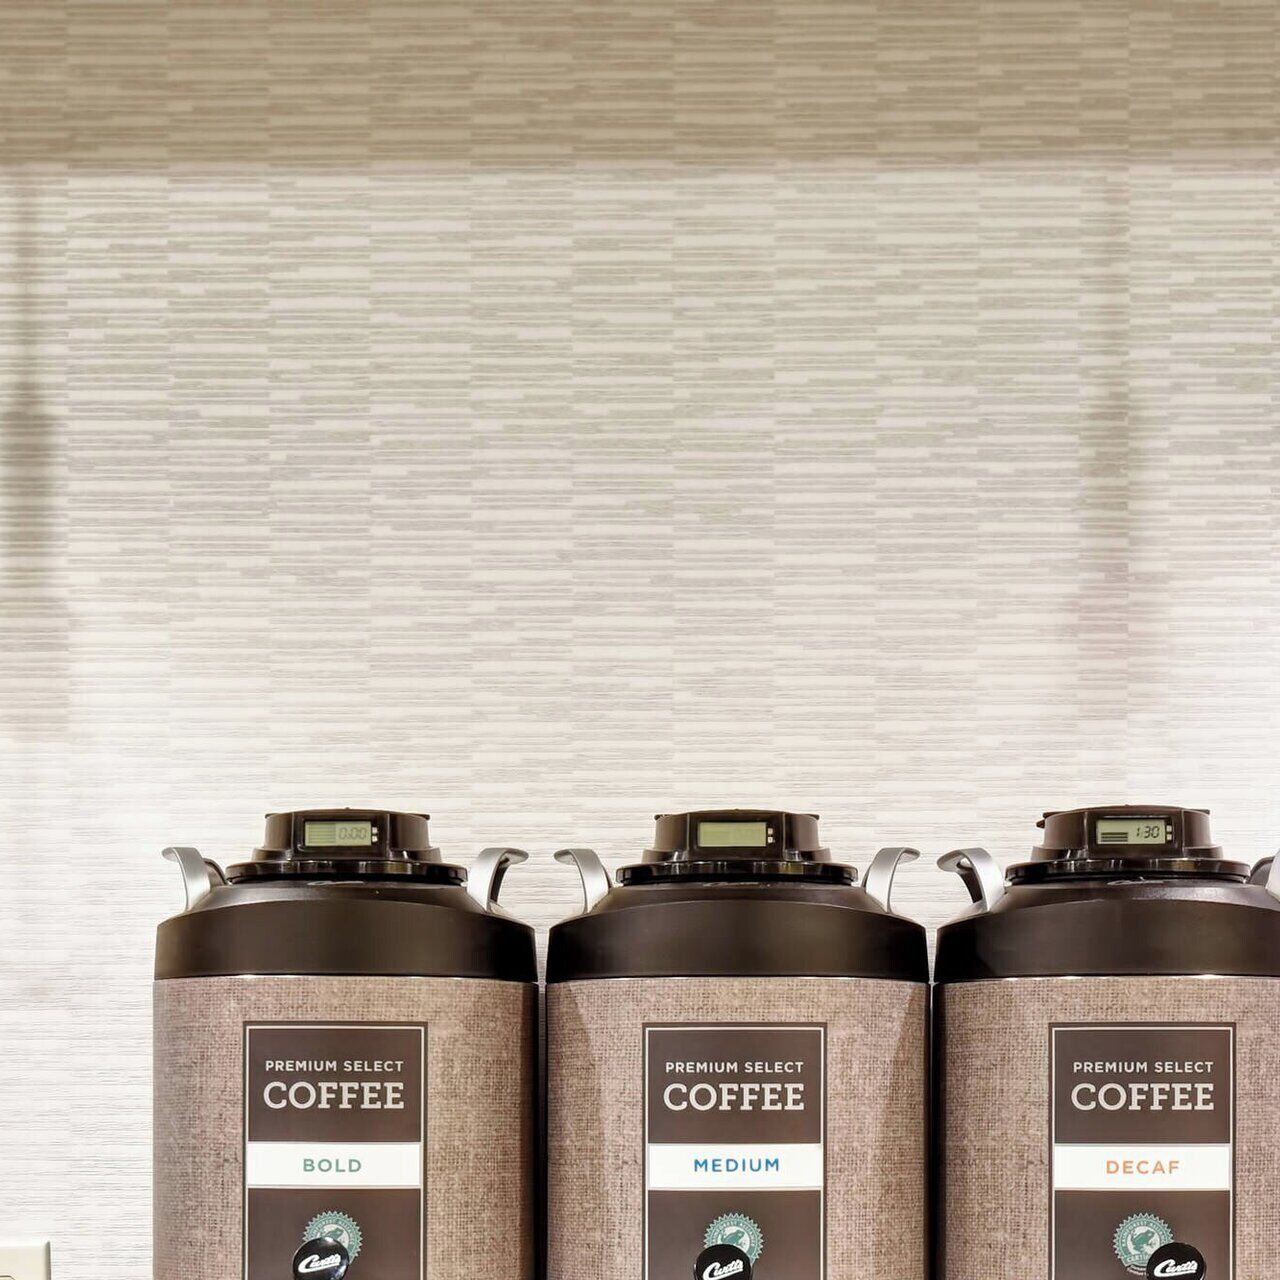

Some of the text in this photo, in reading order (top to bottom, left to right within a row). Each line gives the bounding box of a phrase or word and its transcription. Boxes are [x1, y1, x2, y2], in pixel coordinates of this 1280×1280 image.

[265, 1060, 404, 1072] PREMIUM SELECT
[665, 1061, 804, 1073] PREMIUM SELECT
[1073, 1061, 1214, 1073] PREMIUM SELECT
[263, 1081, 405, 1109] COFFEE
[663, 1083, 805, 1111] COFFEE
[1071, 1083, 1214, 1111] COFFEE
[303, 1159, 361, 1172] BOLD
[693, 1158, 779, 1172] MEDIUM
[1106, 1160, 1180, 1175] DECAF
